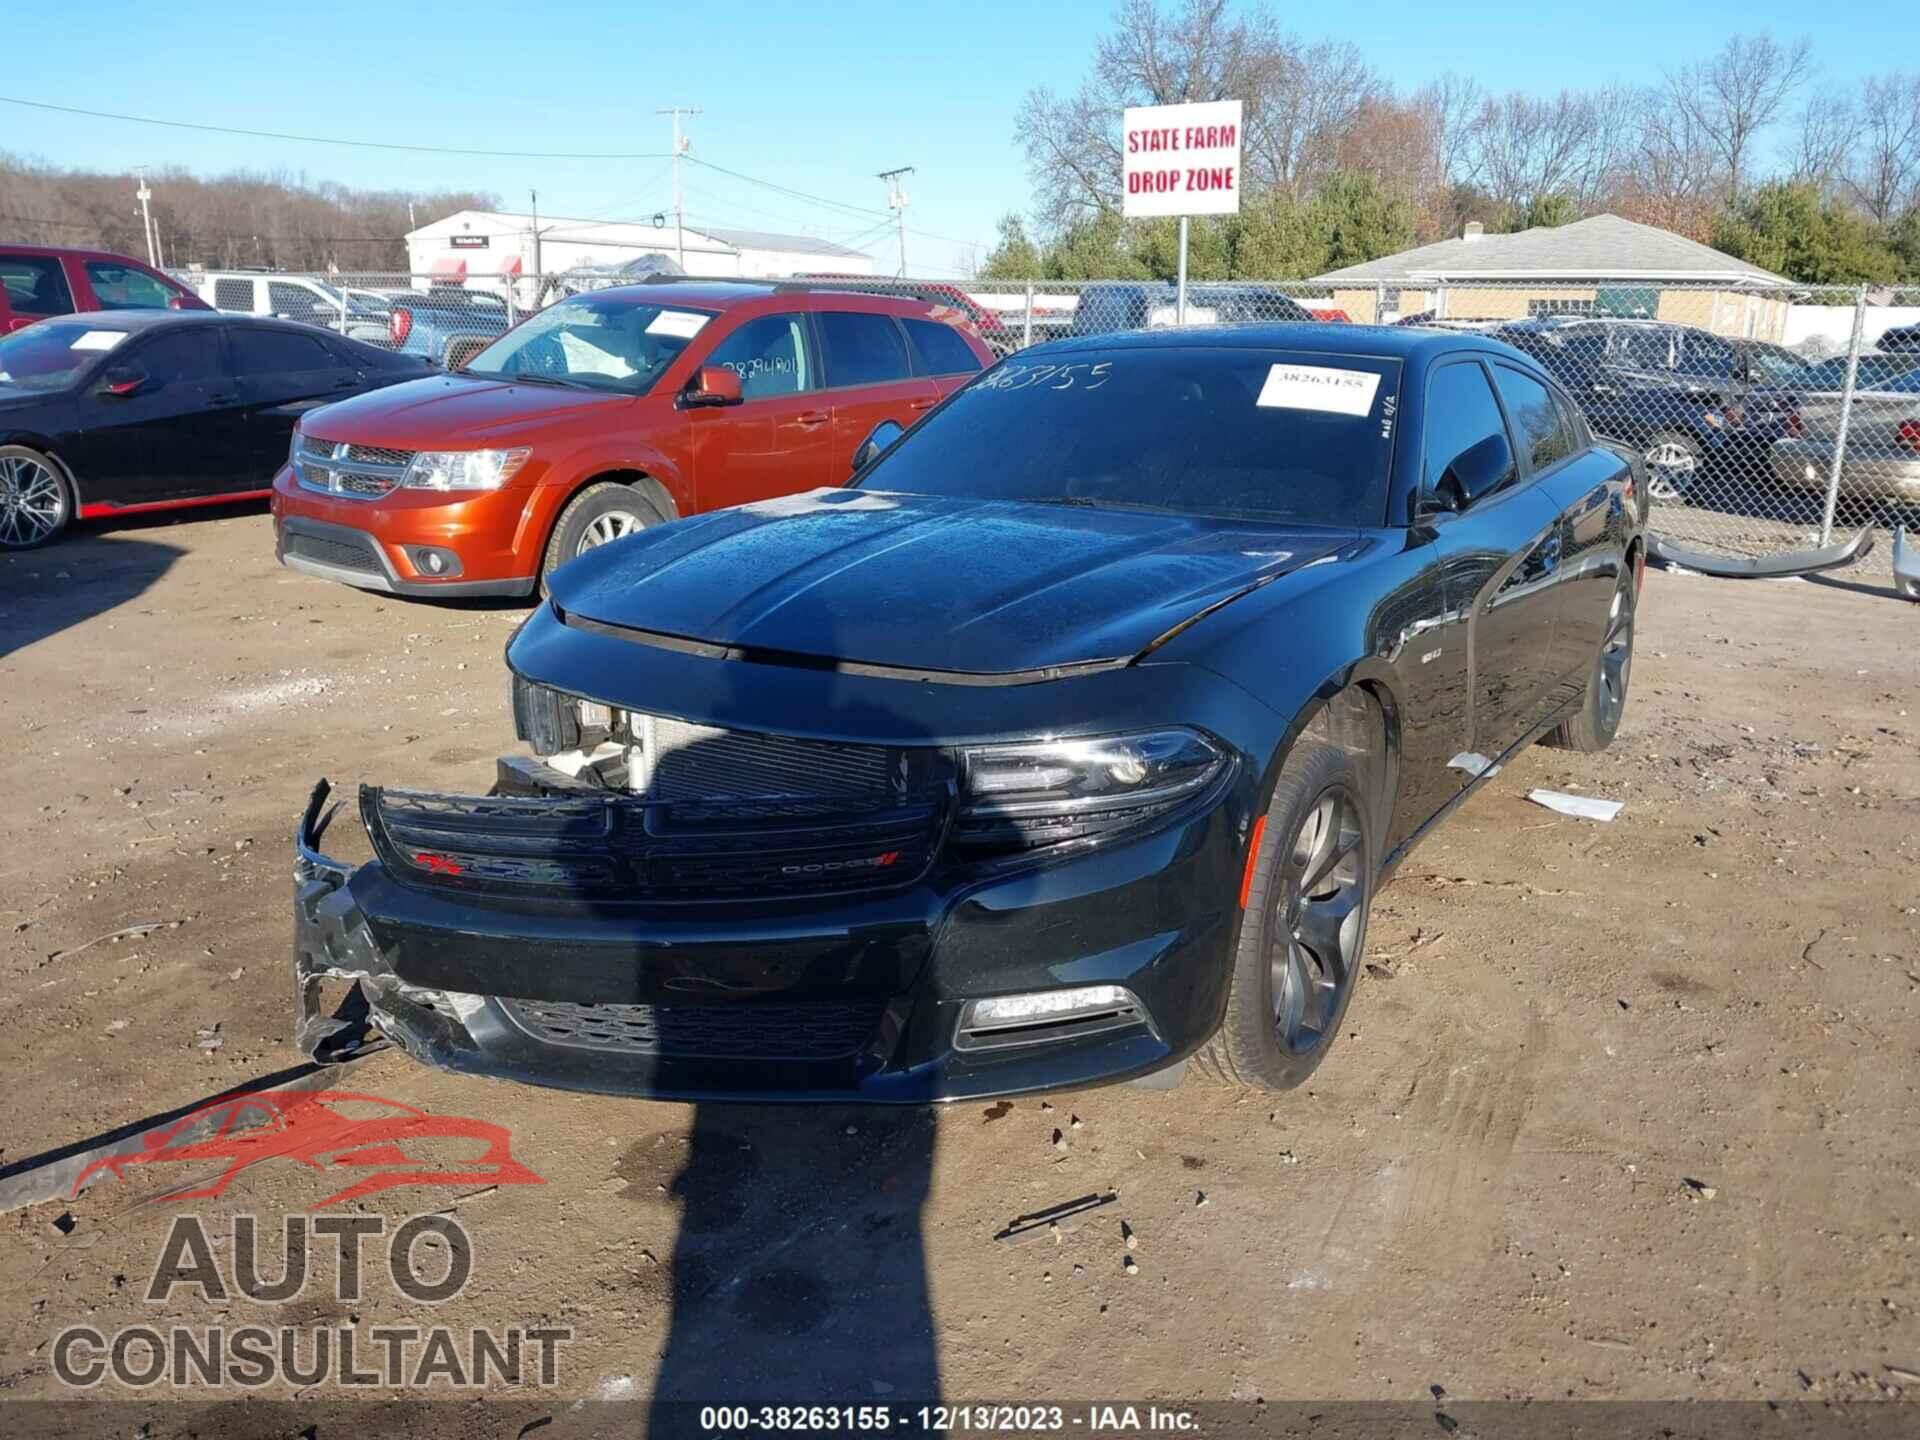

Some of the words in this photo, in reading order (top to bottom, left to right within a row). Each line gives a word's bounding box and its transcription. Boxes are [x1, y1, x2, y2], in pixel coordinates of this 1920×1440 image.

[1128, 128, 1180, 154] STATE
[1185, 125, 1236, 150] FARM
[1128, 169, 1181, 194] DROP
[1185, 167, 1234, 192] ZONE
